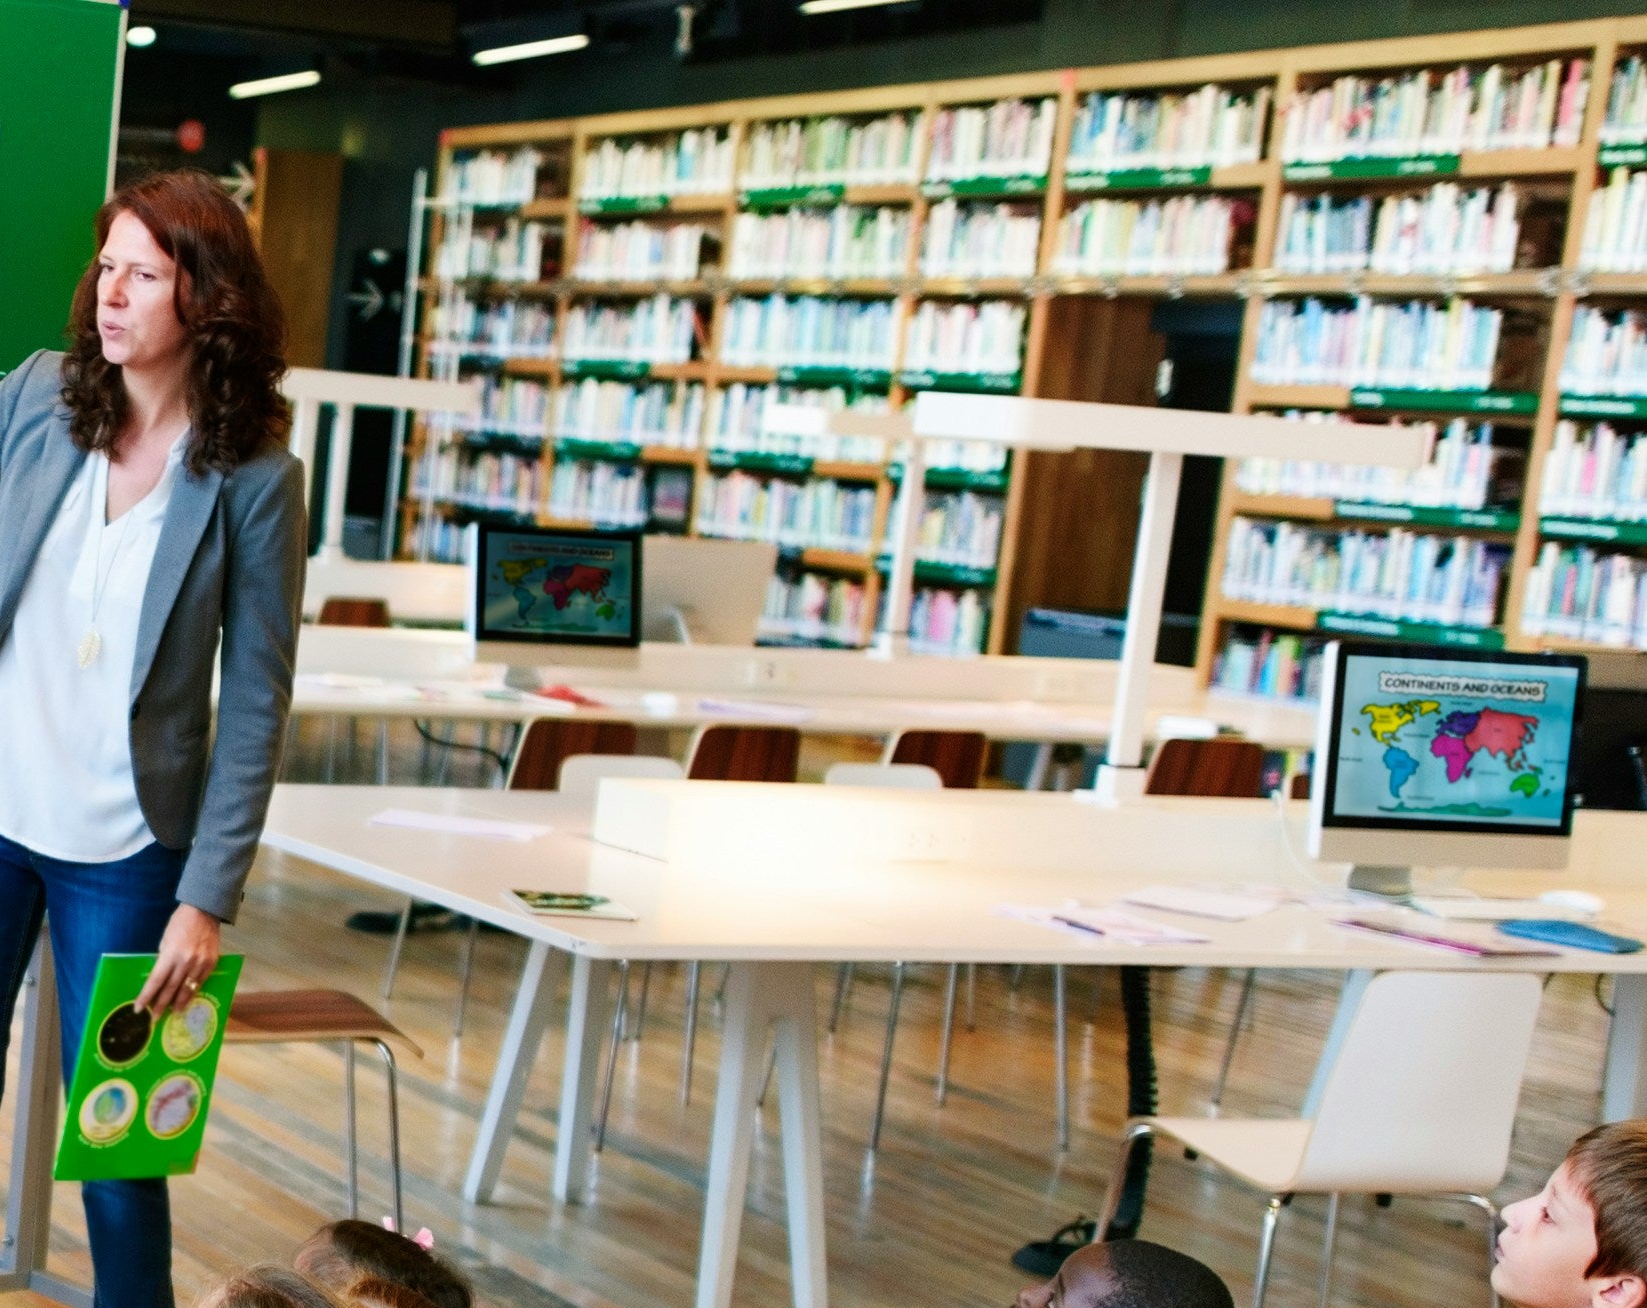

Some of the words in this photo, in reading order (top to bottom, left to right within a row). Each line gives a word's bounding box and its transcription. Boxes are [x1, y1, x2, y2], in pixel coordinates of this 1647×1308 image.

[1384, 677, 1460, 691] CONTINENTS
[1462, 682, 1489, 693] AND
[1490, 684, 1541, 696] OCEANS
